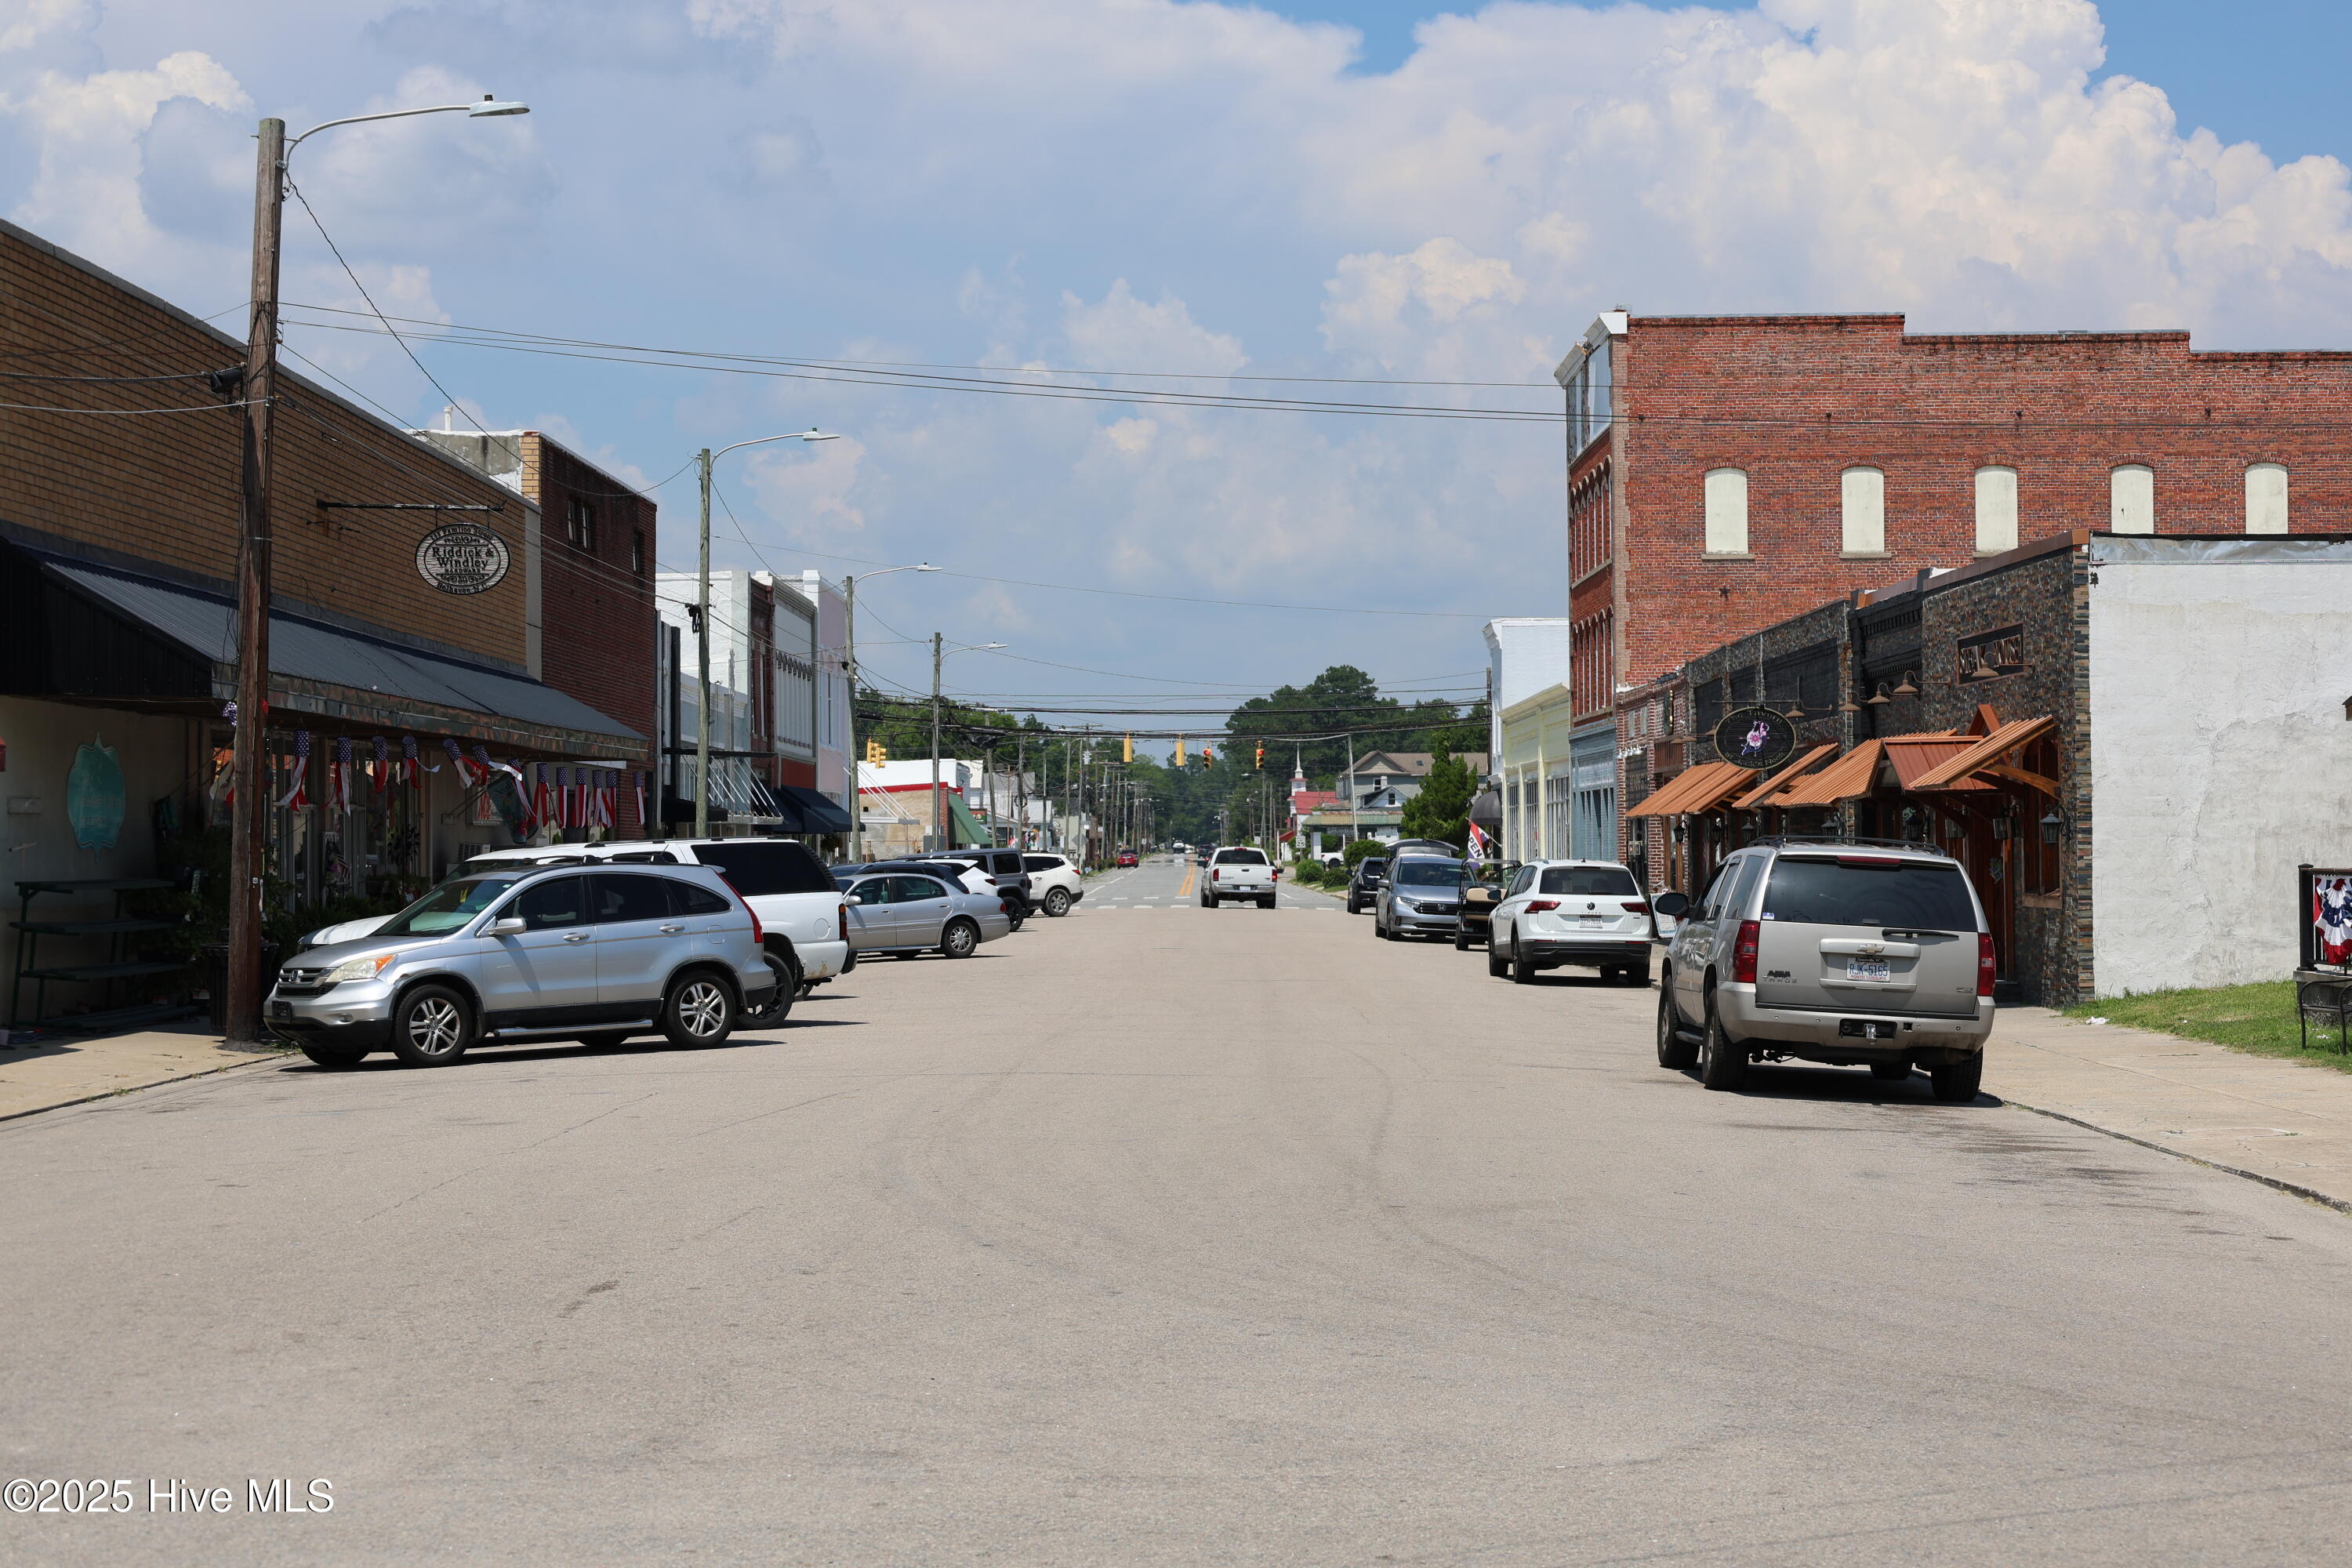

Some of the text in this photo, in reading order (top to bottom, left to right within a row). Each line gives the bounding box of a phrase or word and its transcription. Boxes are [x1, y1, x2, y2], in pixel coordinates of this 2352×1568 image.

[443, 526, 471, 535] Pamlico
[474, 527, 493, 540] Street
[433, 546, 494, 557] Riddick &
[437, 557, 488, 569] Windley
[437, 582, 470, 593] Belhaven
[1727, 710, 1783, 724] The Tavern
[1849, 964, 1888, 976] RJK-5165
